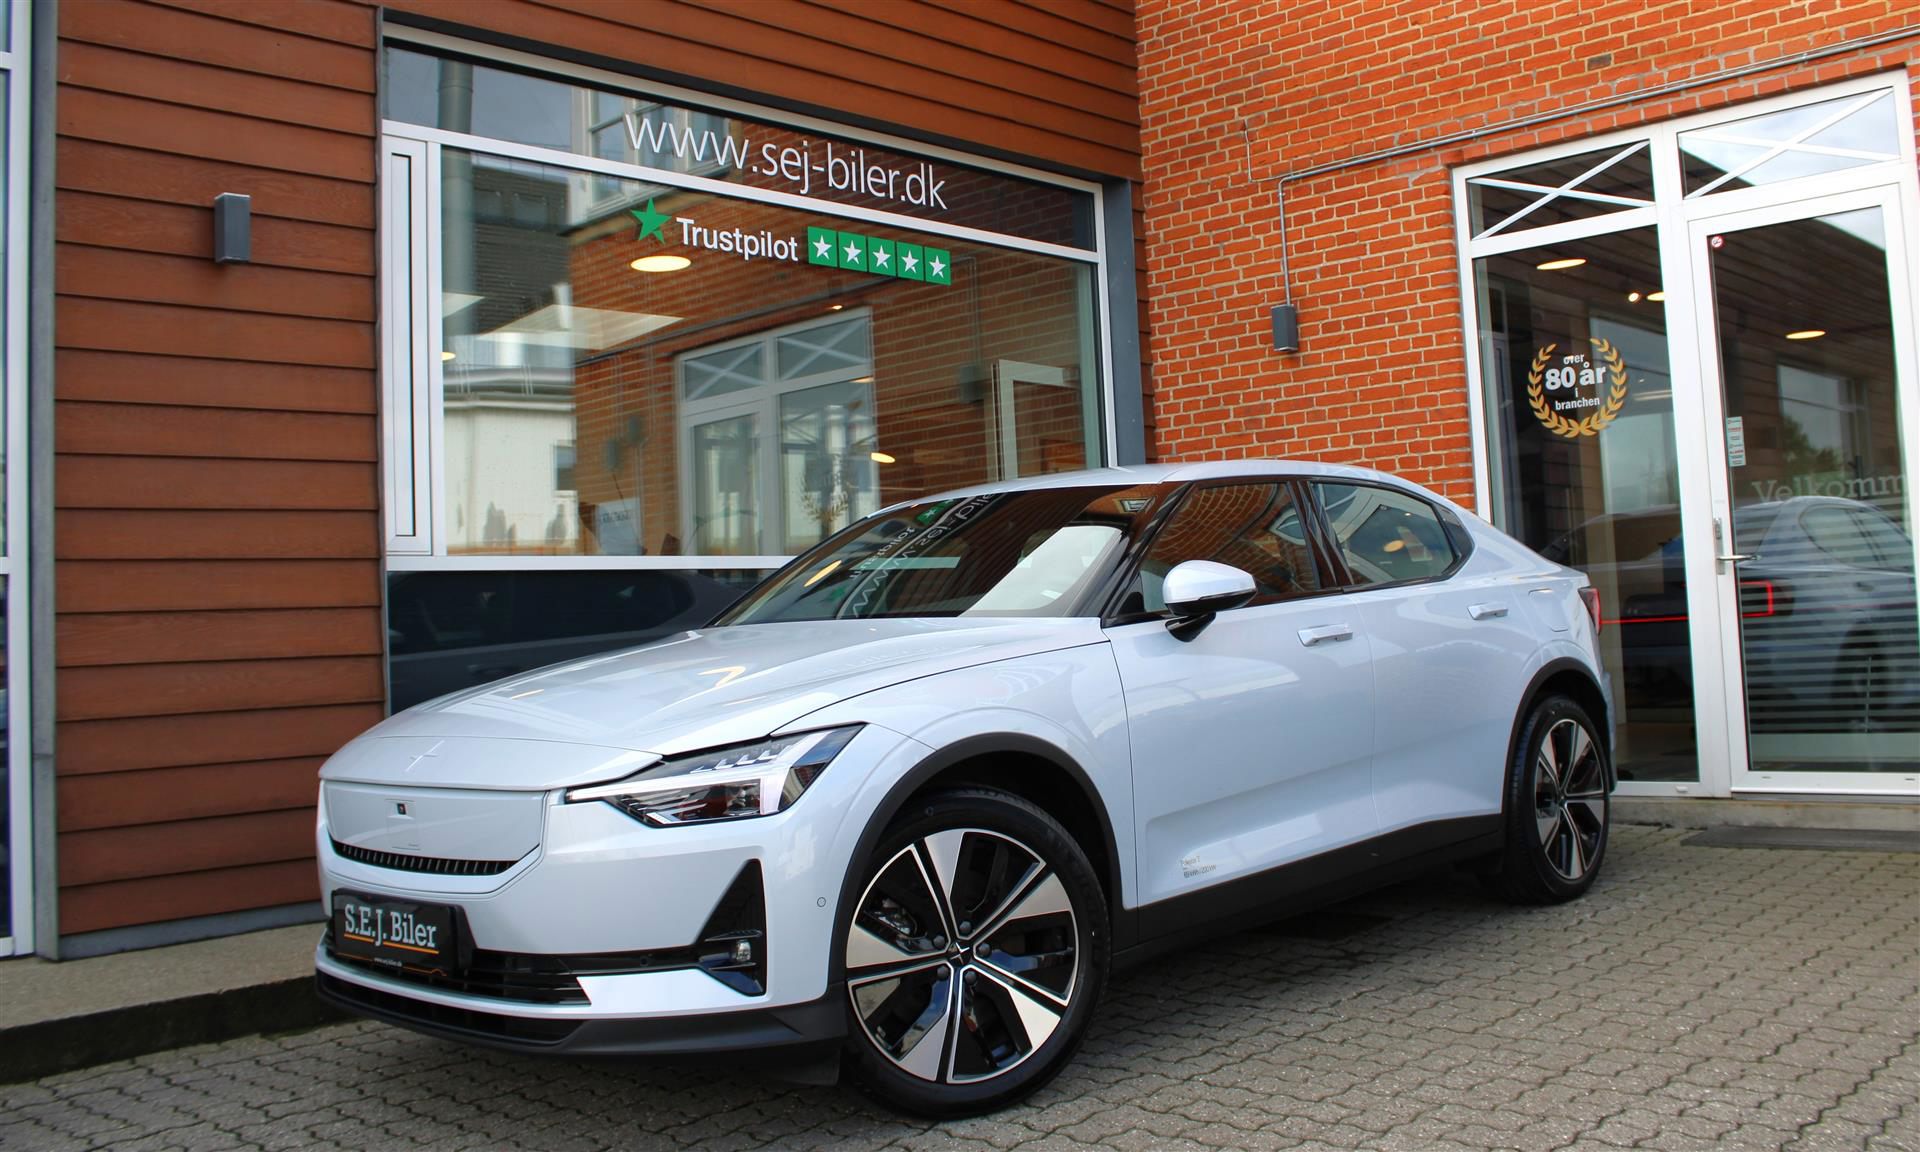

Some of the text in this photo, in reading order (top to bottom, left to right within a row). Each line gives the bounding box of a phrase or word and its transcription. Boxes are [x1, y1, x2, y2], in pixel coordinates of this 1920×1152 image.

[624, 113, 948, 210] www.sej-biler.dk
[676, 217, 798, 261] Trustpilot
[1563, 354, 1585, 365] over
[1545, 361, 1606, 390] 80 år
[1555, 397, 1600, 411] branchen
[1574, 387, 1579, 398] i
[390, 911, 437, 948] Biler
